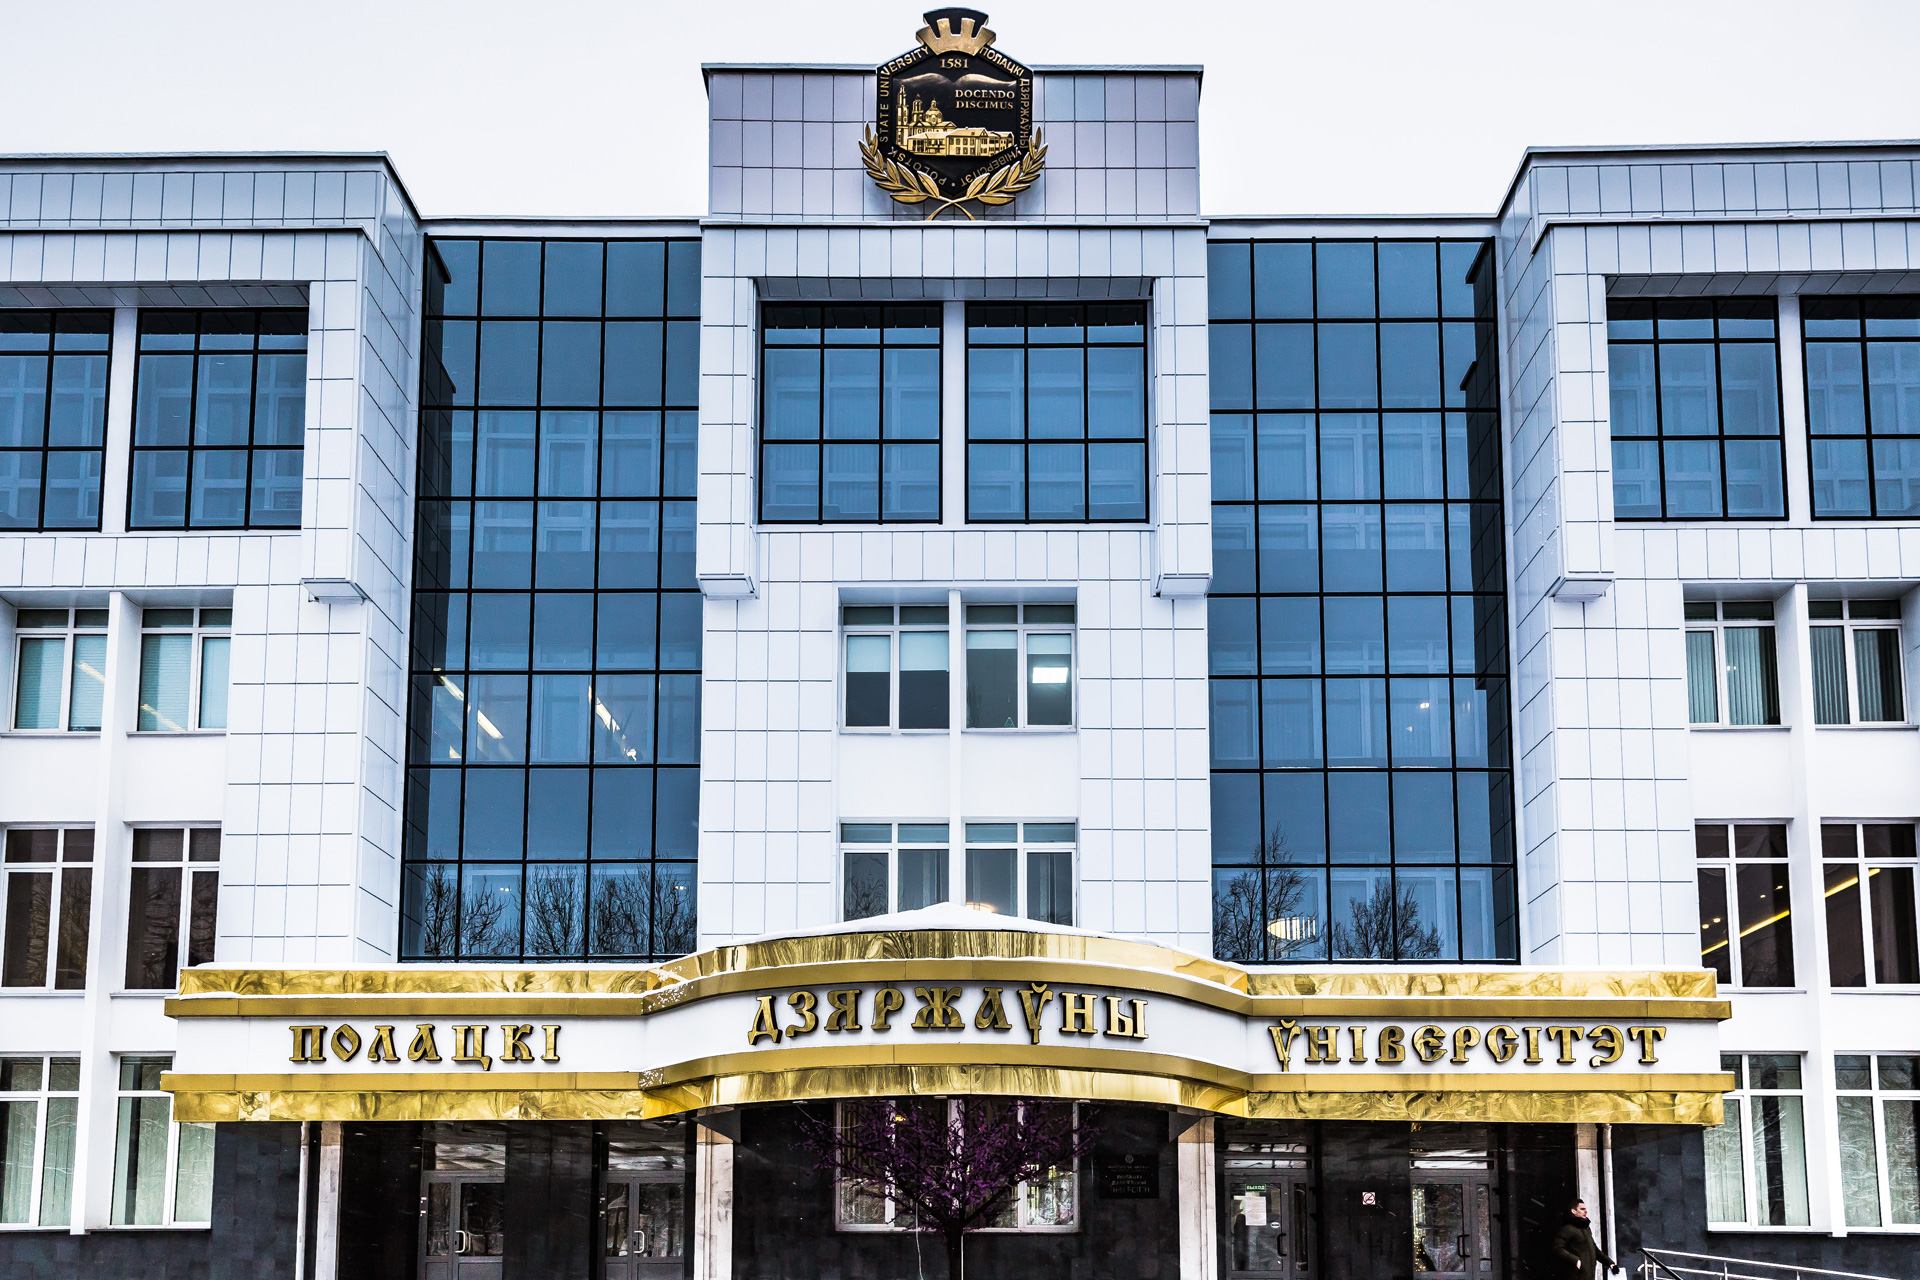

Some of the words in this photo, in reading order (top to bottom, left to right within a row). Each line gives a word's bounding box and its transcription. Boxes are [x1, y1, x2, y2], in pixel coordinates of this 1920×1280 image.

[880, 46, 929, 97] UNIVERSITY
[939, 58, 969, 69] 1581
[979, 46, 1024, 77] ПОЛАЦКІ
[955, 89, 1015, 99] DOCENDO
[956, 101, 1014, 110] DISCIMUS
[880, 103, 889, 143] STATE
[887, 146, 947, 186] POLOTSK
[289, 1024, 562, 1072] ПОЛАЦКІ
[747, 983, 1149, 1045] ДЗЯРЖАЎНЫ
[1267, 1019, 1667, 1072] ЎНІВЕРСІТЭТ
